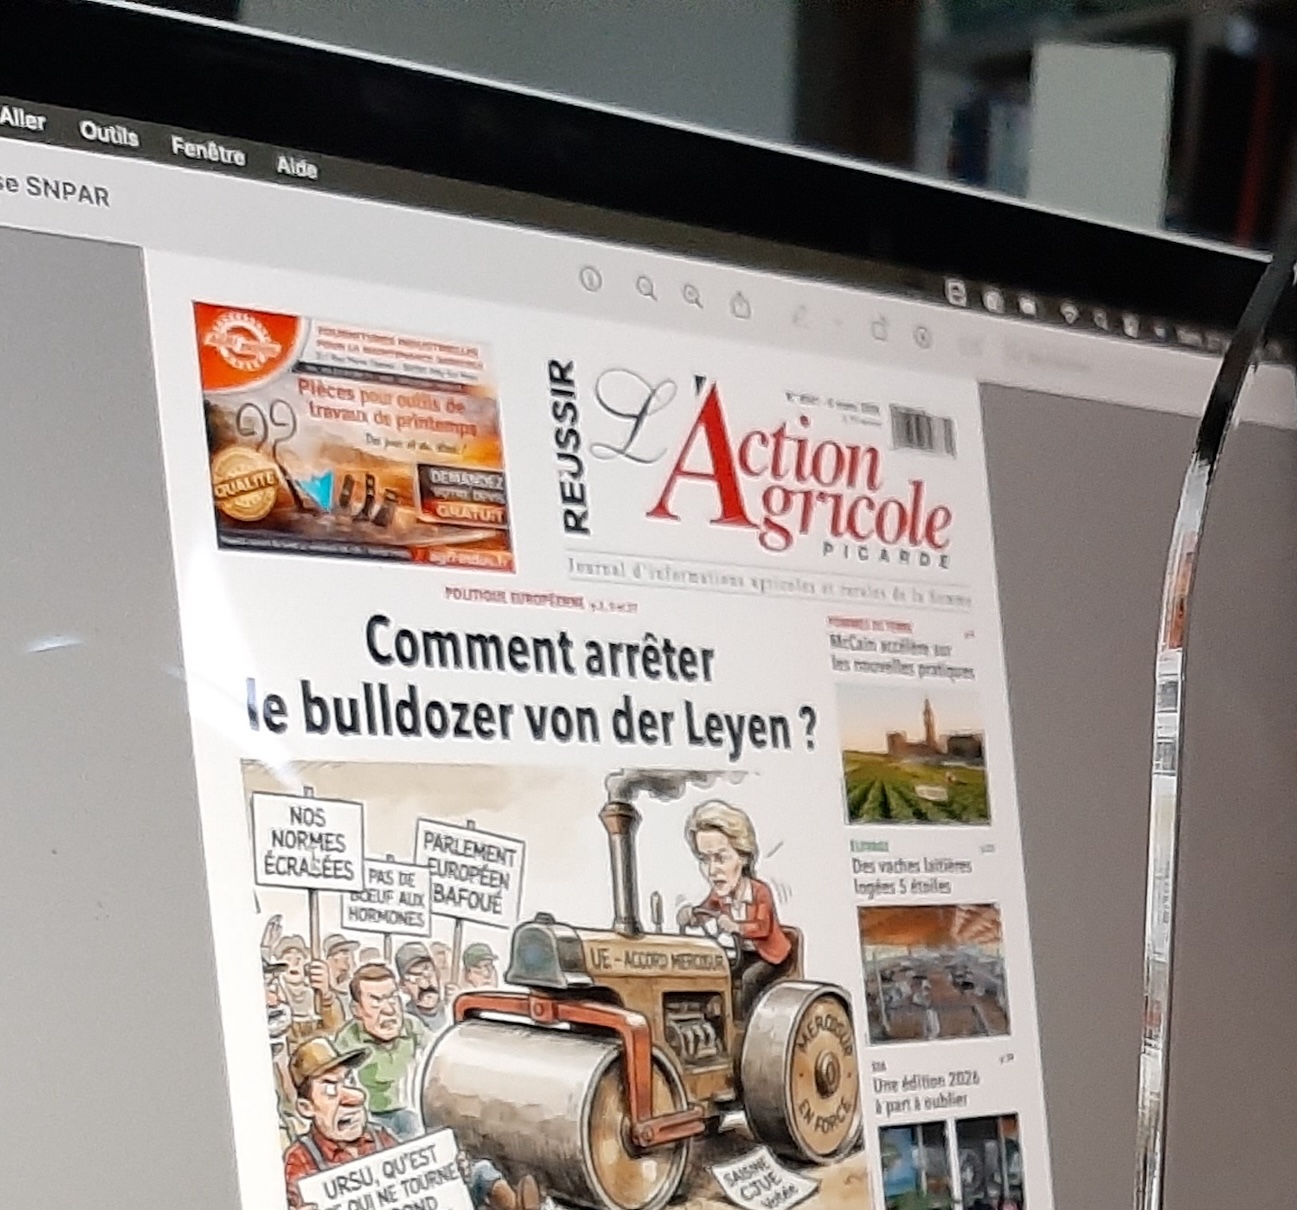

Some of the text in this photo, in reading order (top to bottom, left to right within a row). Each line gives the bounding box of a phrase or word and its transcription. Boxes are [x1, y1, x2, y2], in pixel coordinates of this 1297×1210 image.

[1, 106, 318, 181] Aller Outils Fenêtre Aide
[27, 176, 110, 207] SNPAR
[297, 377, 354, 402] Pièces
[823, 541, 949, 569] PICARDE
[568, 557, 625, 577] Journal
[633, 562, 745, 588] d'informations
[365, 613, 714, 683] Comment arrêter
[245, 677, 288, 734] le
[300, 679, 513, 740] bulldozer
[525, 703, 599, 743] von
[611, 695, 675, 746] der
[685, 698, 791, 760] Leyen
[290, 807, 326, 827] NOS
[272, 830, 346, 853] NORMES
[424, 830, 517, 868] PARLEMENT
[264, 851, 354, 880] ÉCRASÉES
[369, 868, 416, 888] PAS DE
[427, 857, 510, 891] EUROPÉEN
[852, 857, 875, 874] Des
[434, 884, 503, 915] BAFOUÉ
[348, 906, 425, 927] HORMONES
[591, 948, 611, 969] UE
[873, 1078, 898, 1093] Une
[323, 1145, 438, 1200] URSU, QU'EST
[379, 1187, 398, 1207] NE
[401, 1162, 459, 1198] TOURNE
